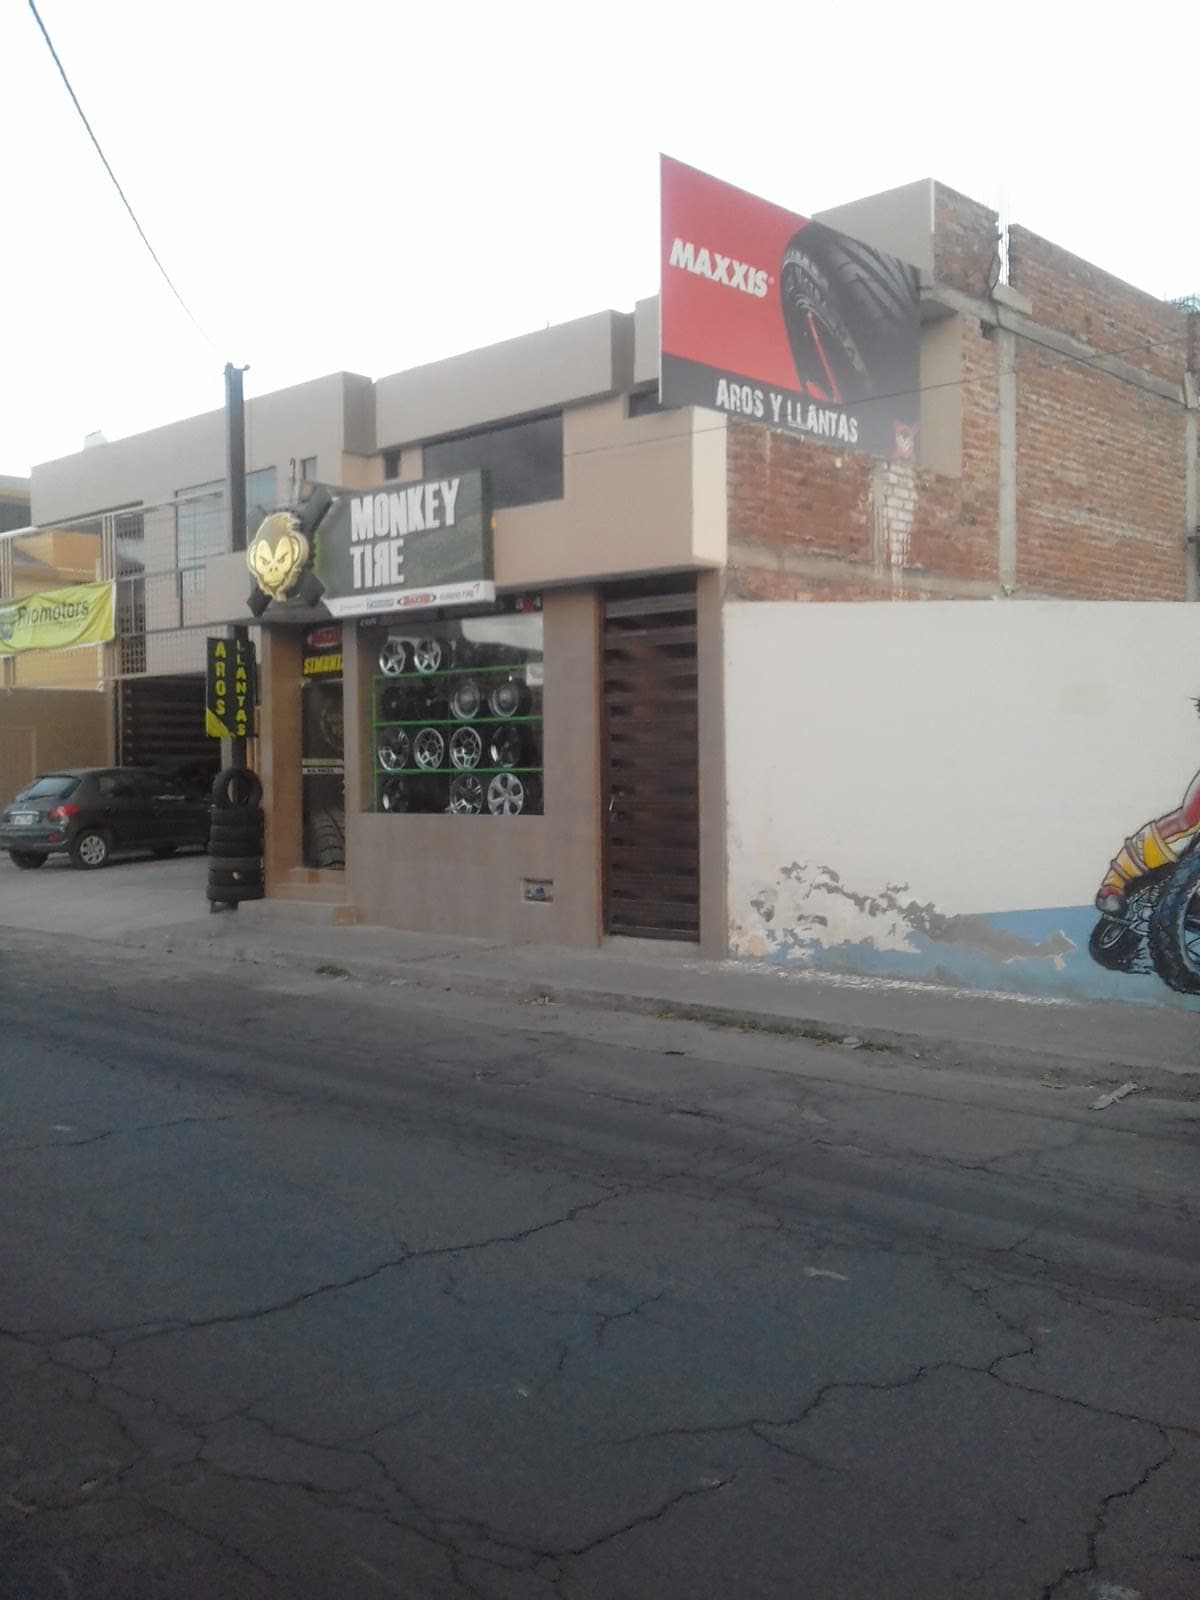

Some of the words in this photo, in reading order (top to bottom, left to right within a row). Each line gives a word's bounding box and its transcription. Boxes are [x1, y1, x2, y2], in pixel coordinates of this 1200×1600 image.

[669, 237, 768, 298] MAXXIS
[716, 379, 764, 418] AROS
[770, 392, 782, 423] Y
[787, 399, 859, 443] LLANTAS
[350, 478, 460, 542] MONKEY
[215, 639, 227, 716] AROS
[236, 639, 248, 737] LLANTAS
